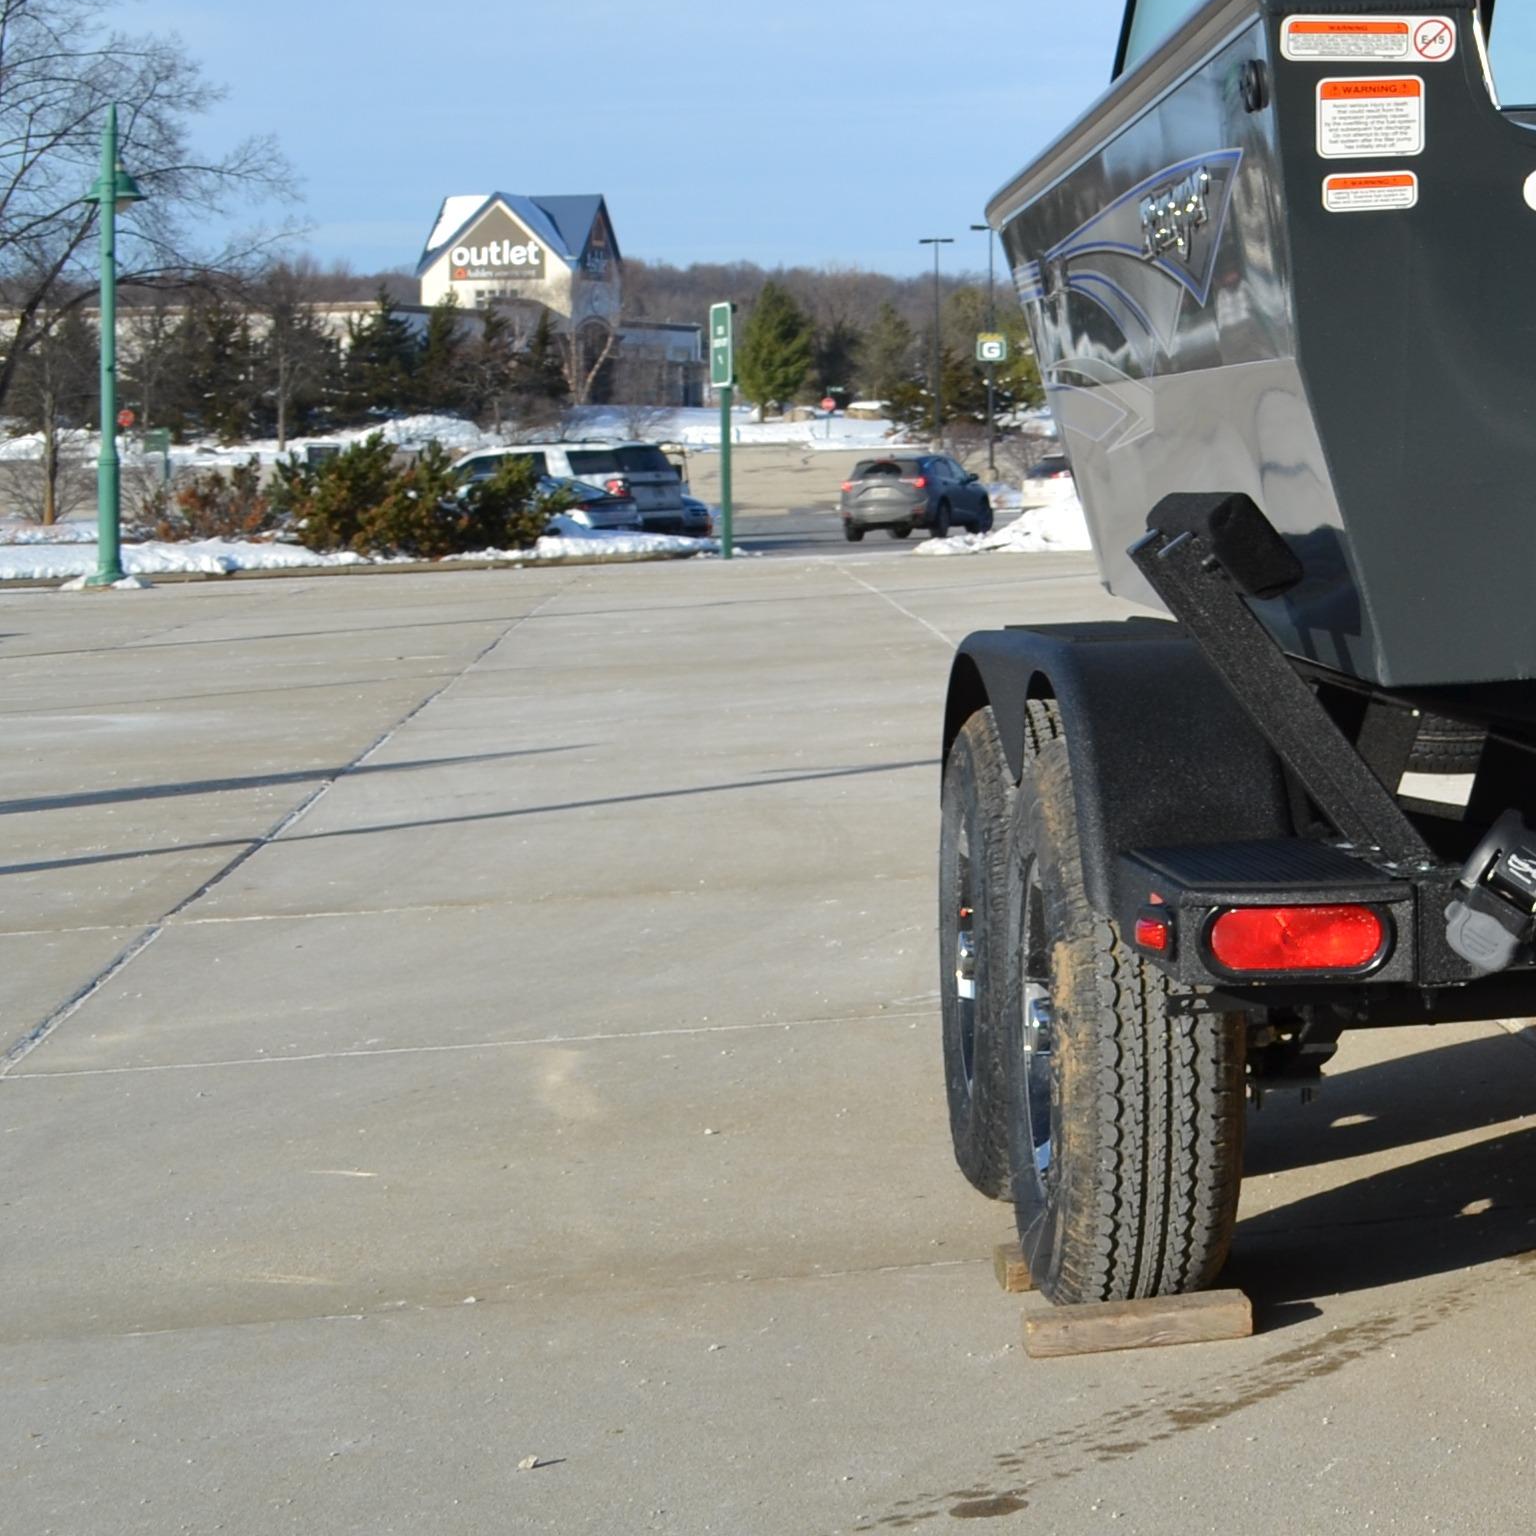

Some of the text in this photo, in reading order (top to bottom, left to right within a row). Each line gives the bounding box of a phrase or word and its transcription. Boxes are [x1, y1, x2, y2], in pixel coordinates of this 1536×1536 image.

[1342, 85, 1397, 94] WARNING
[451, 239, 540, 266] outlet
[982, 342, 1000, 358] G
